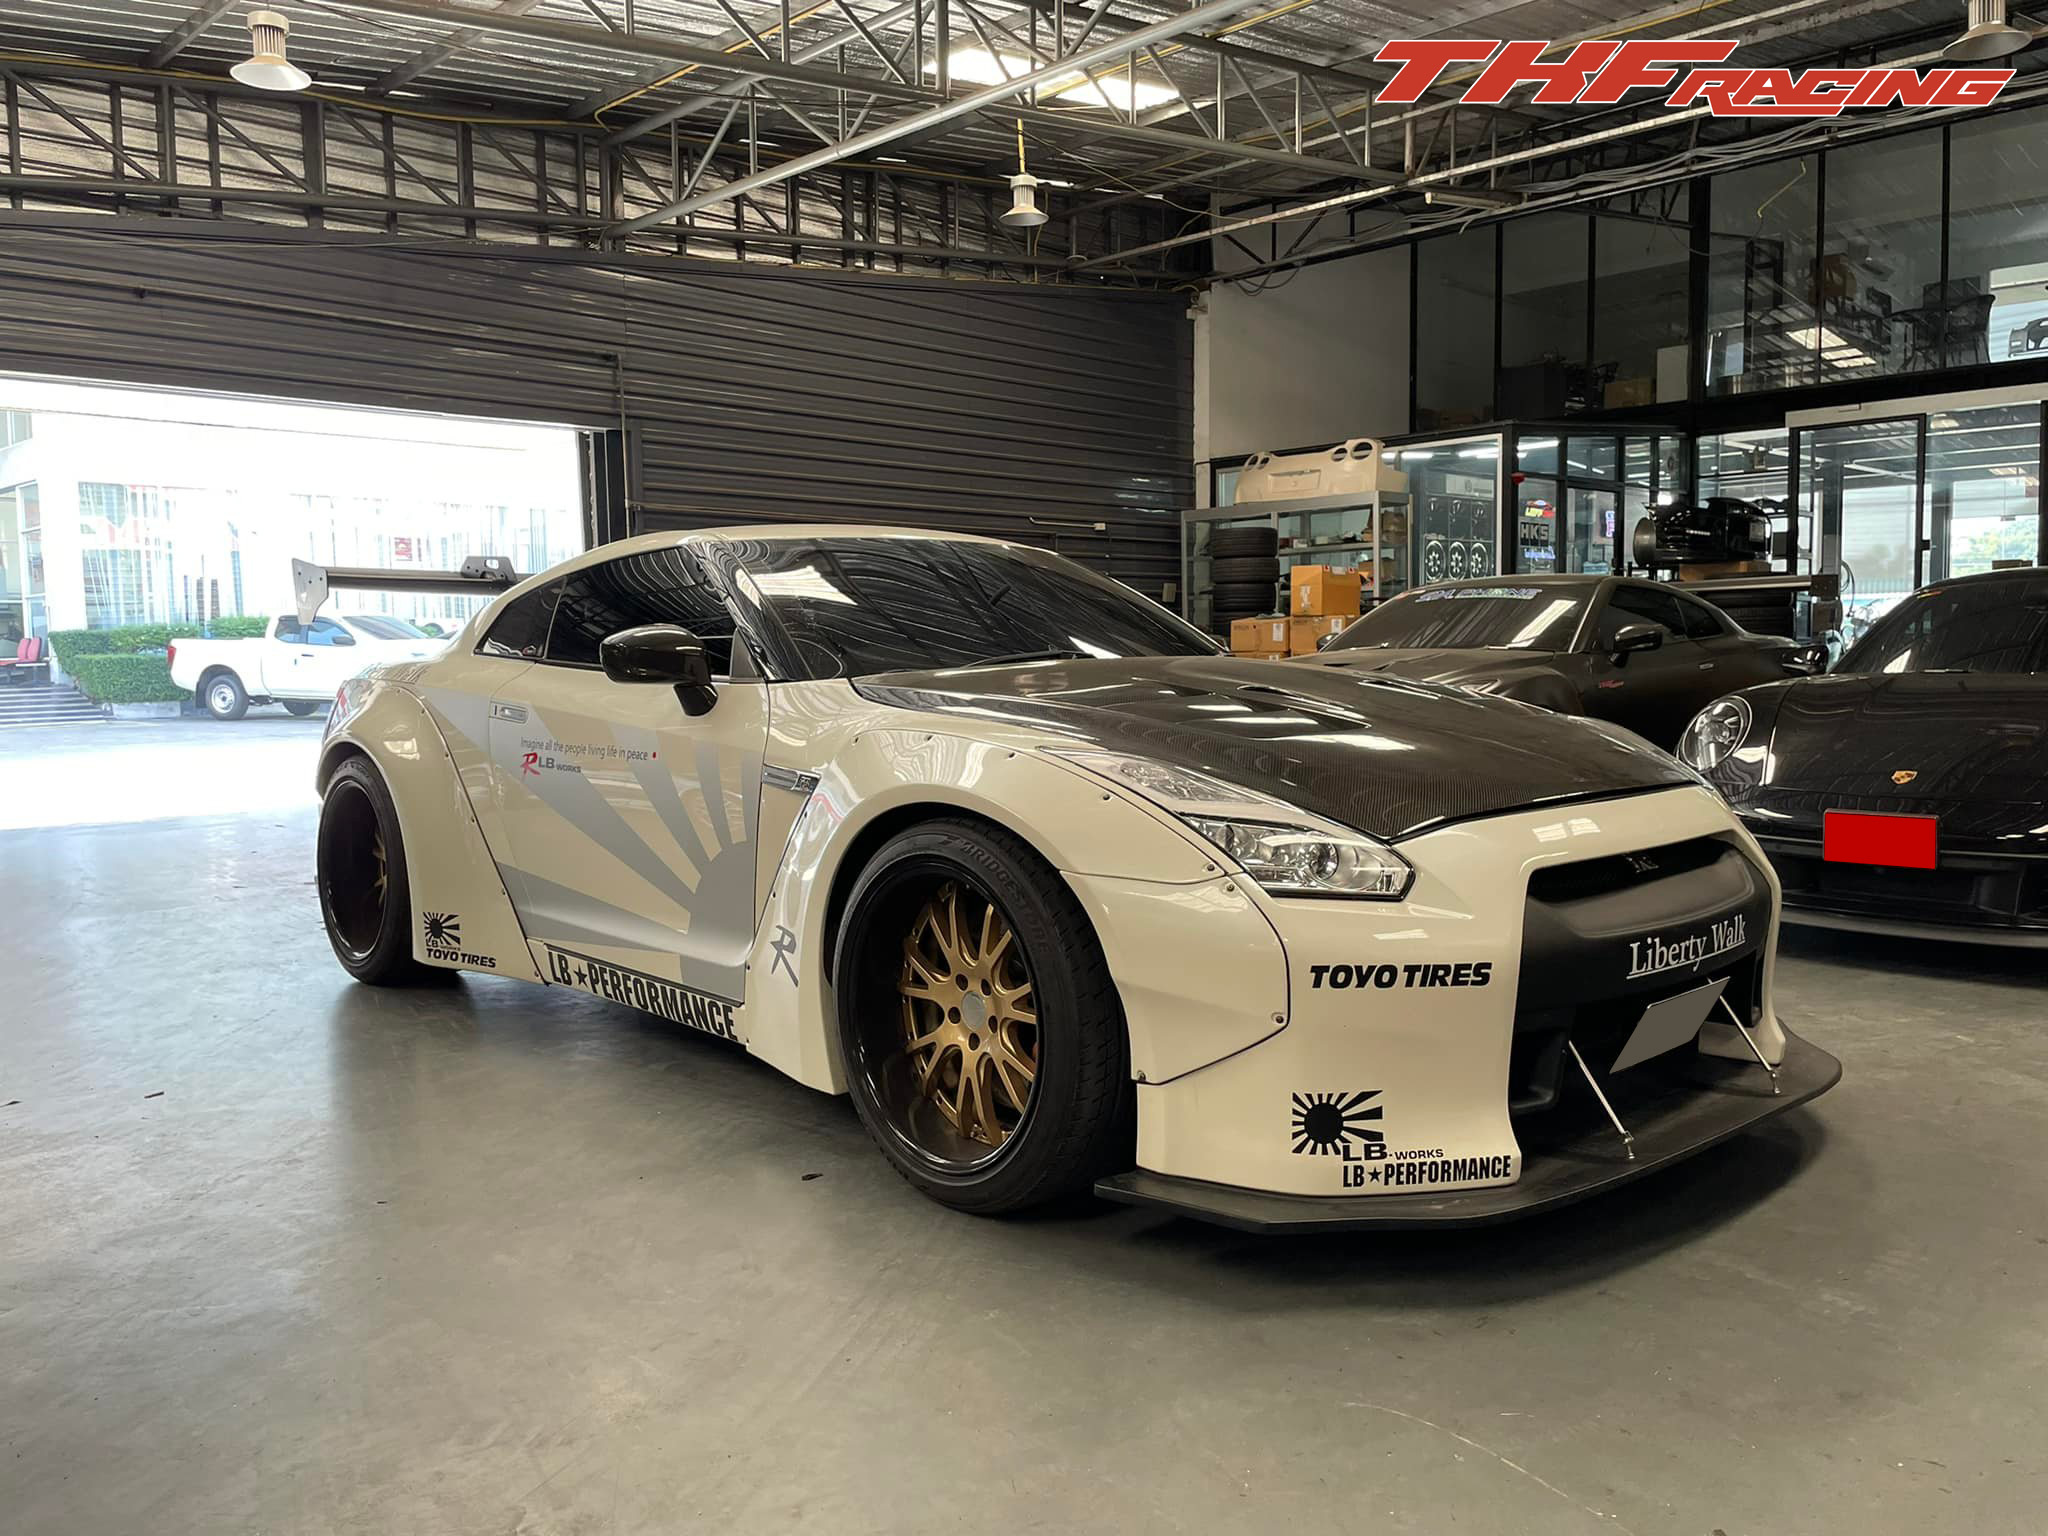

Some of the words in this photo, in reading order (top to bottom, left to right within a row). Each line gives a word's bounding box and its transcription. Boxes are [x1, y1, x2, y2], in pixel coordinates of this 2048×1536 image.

[1520, 523, 1549, 540] HKS
[520, 736, 544, 751] Imagine
[553, 741, 563, 752] the
[565, 743, 586, 755] people
[588, 744, 605, 759] living
[607, 745, 617, 757] life
[619, 747, 625, 758] in
[627, 750, 648, 762] peace
[538, 756, 554, 768] LB
[1629, 937, 1708, 975] Liberty
[1711, 914, 1746, 952] Walk
[426, 948, 459, 961] TOYO
[460, 953, 497, 968] TIRES
[1310, 965, 1398, 989] TOYO
[1403, 962, 1492, 988] TIRES
[548, 951, 572, 986] LB
[587, 963, 737, 1041] PERFORMANCE
[1343, 1165, 1365, 1188] LB
[1384, 1155, 1511, 1186] PERFORMANCE
